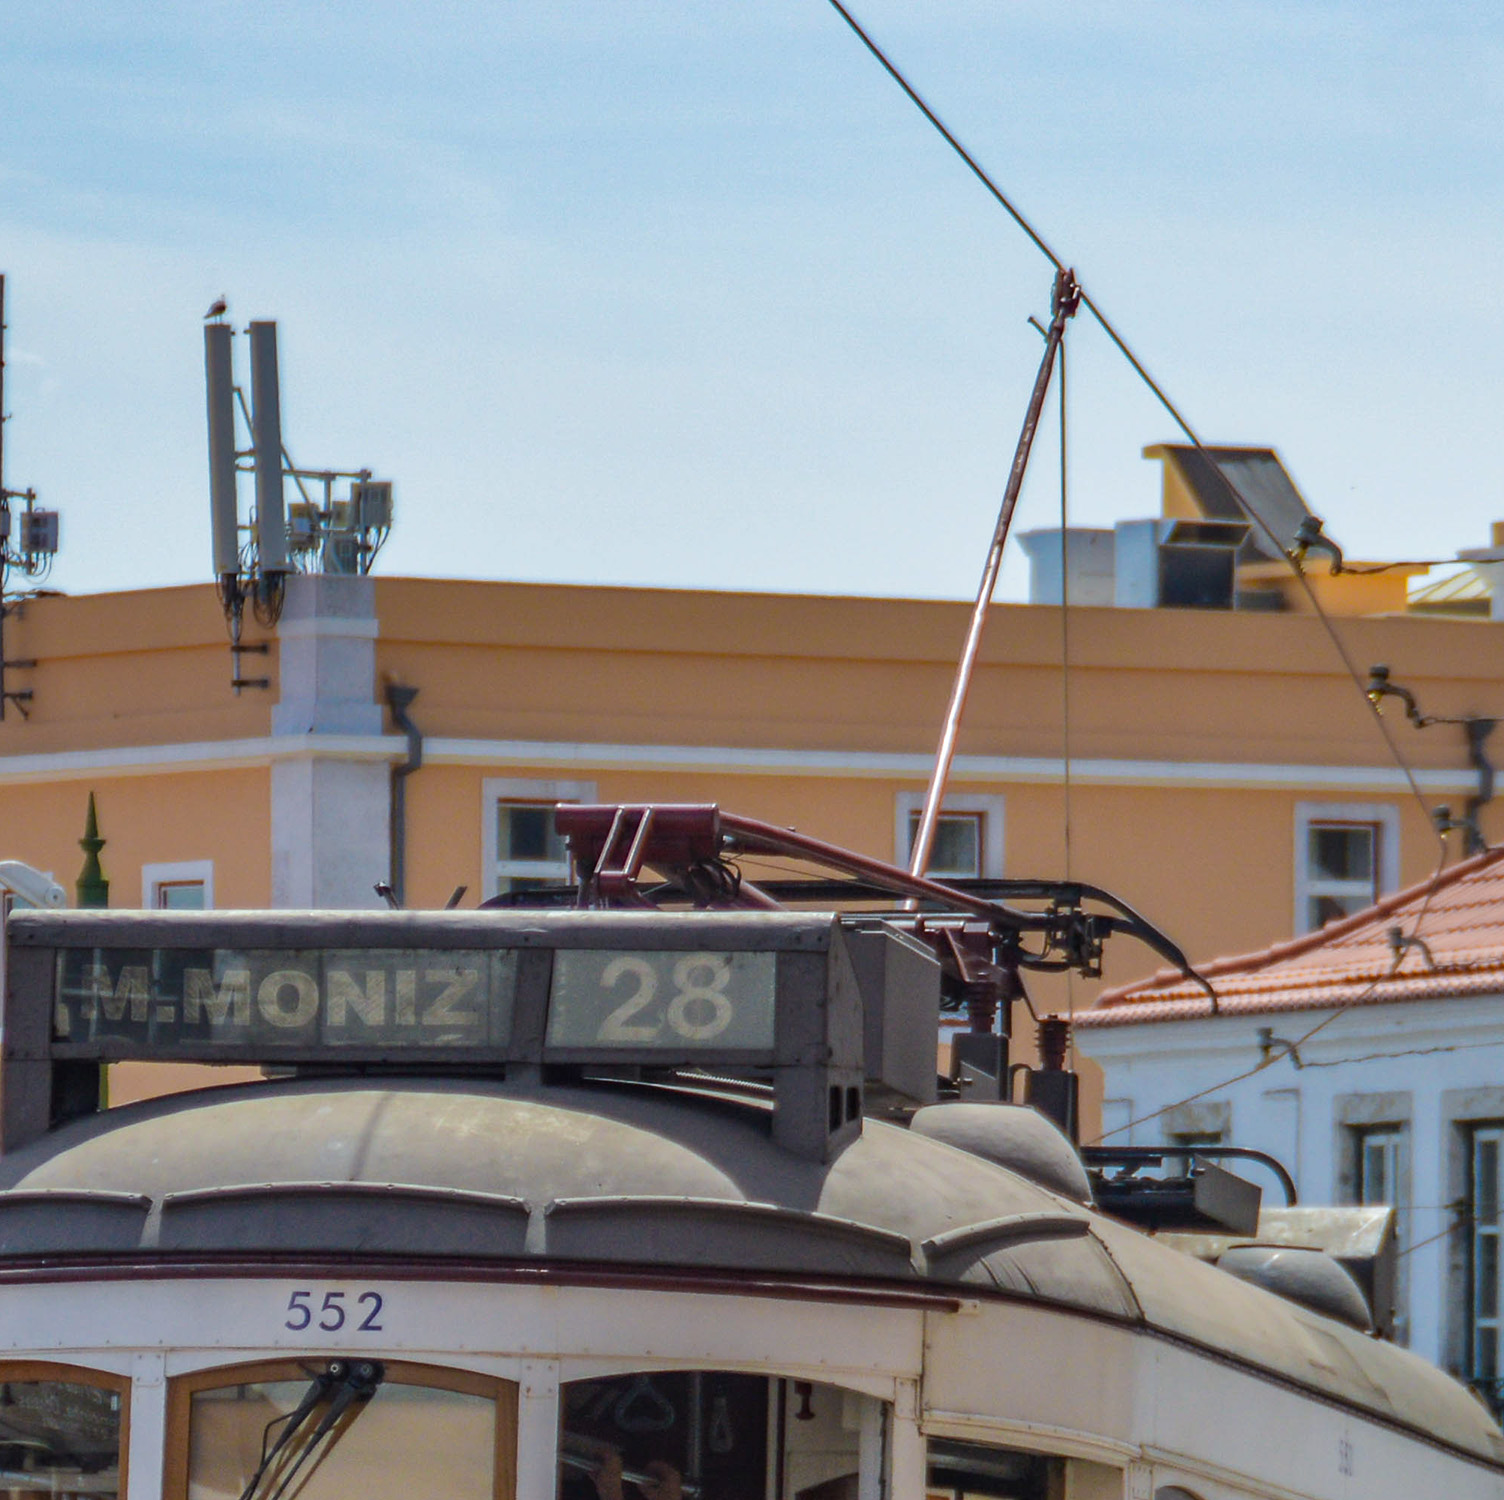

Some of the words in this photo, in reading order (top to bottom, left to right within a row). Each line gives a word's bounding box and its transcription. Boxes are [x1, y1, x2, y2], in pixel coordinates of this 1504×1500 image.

[81, 964, 480, 1028] M.MONIZ
[599, 955, 734, 1042] 28
[285, 1291, 385, 1332] 552
